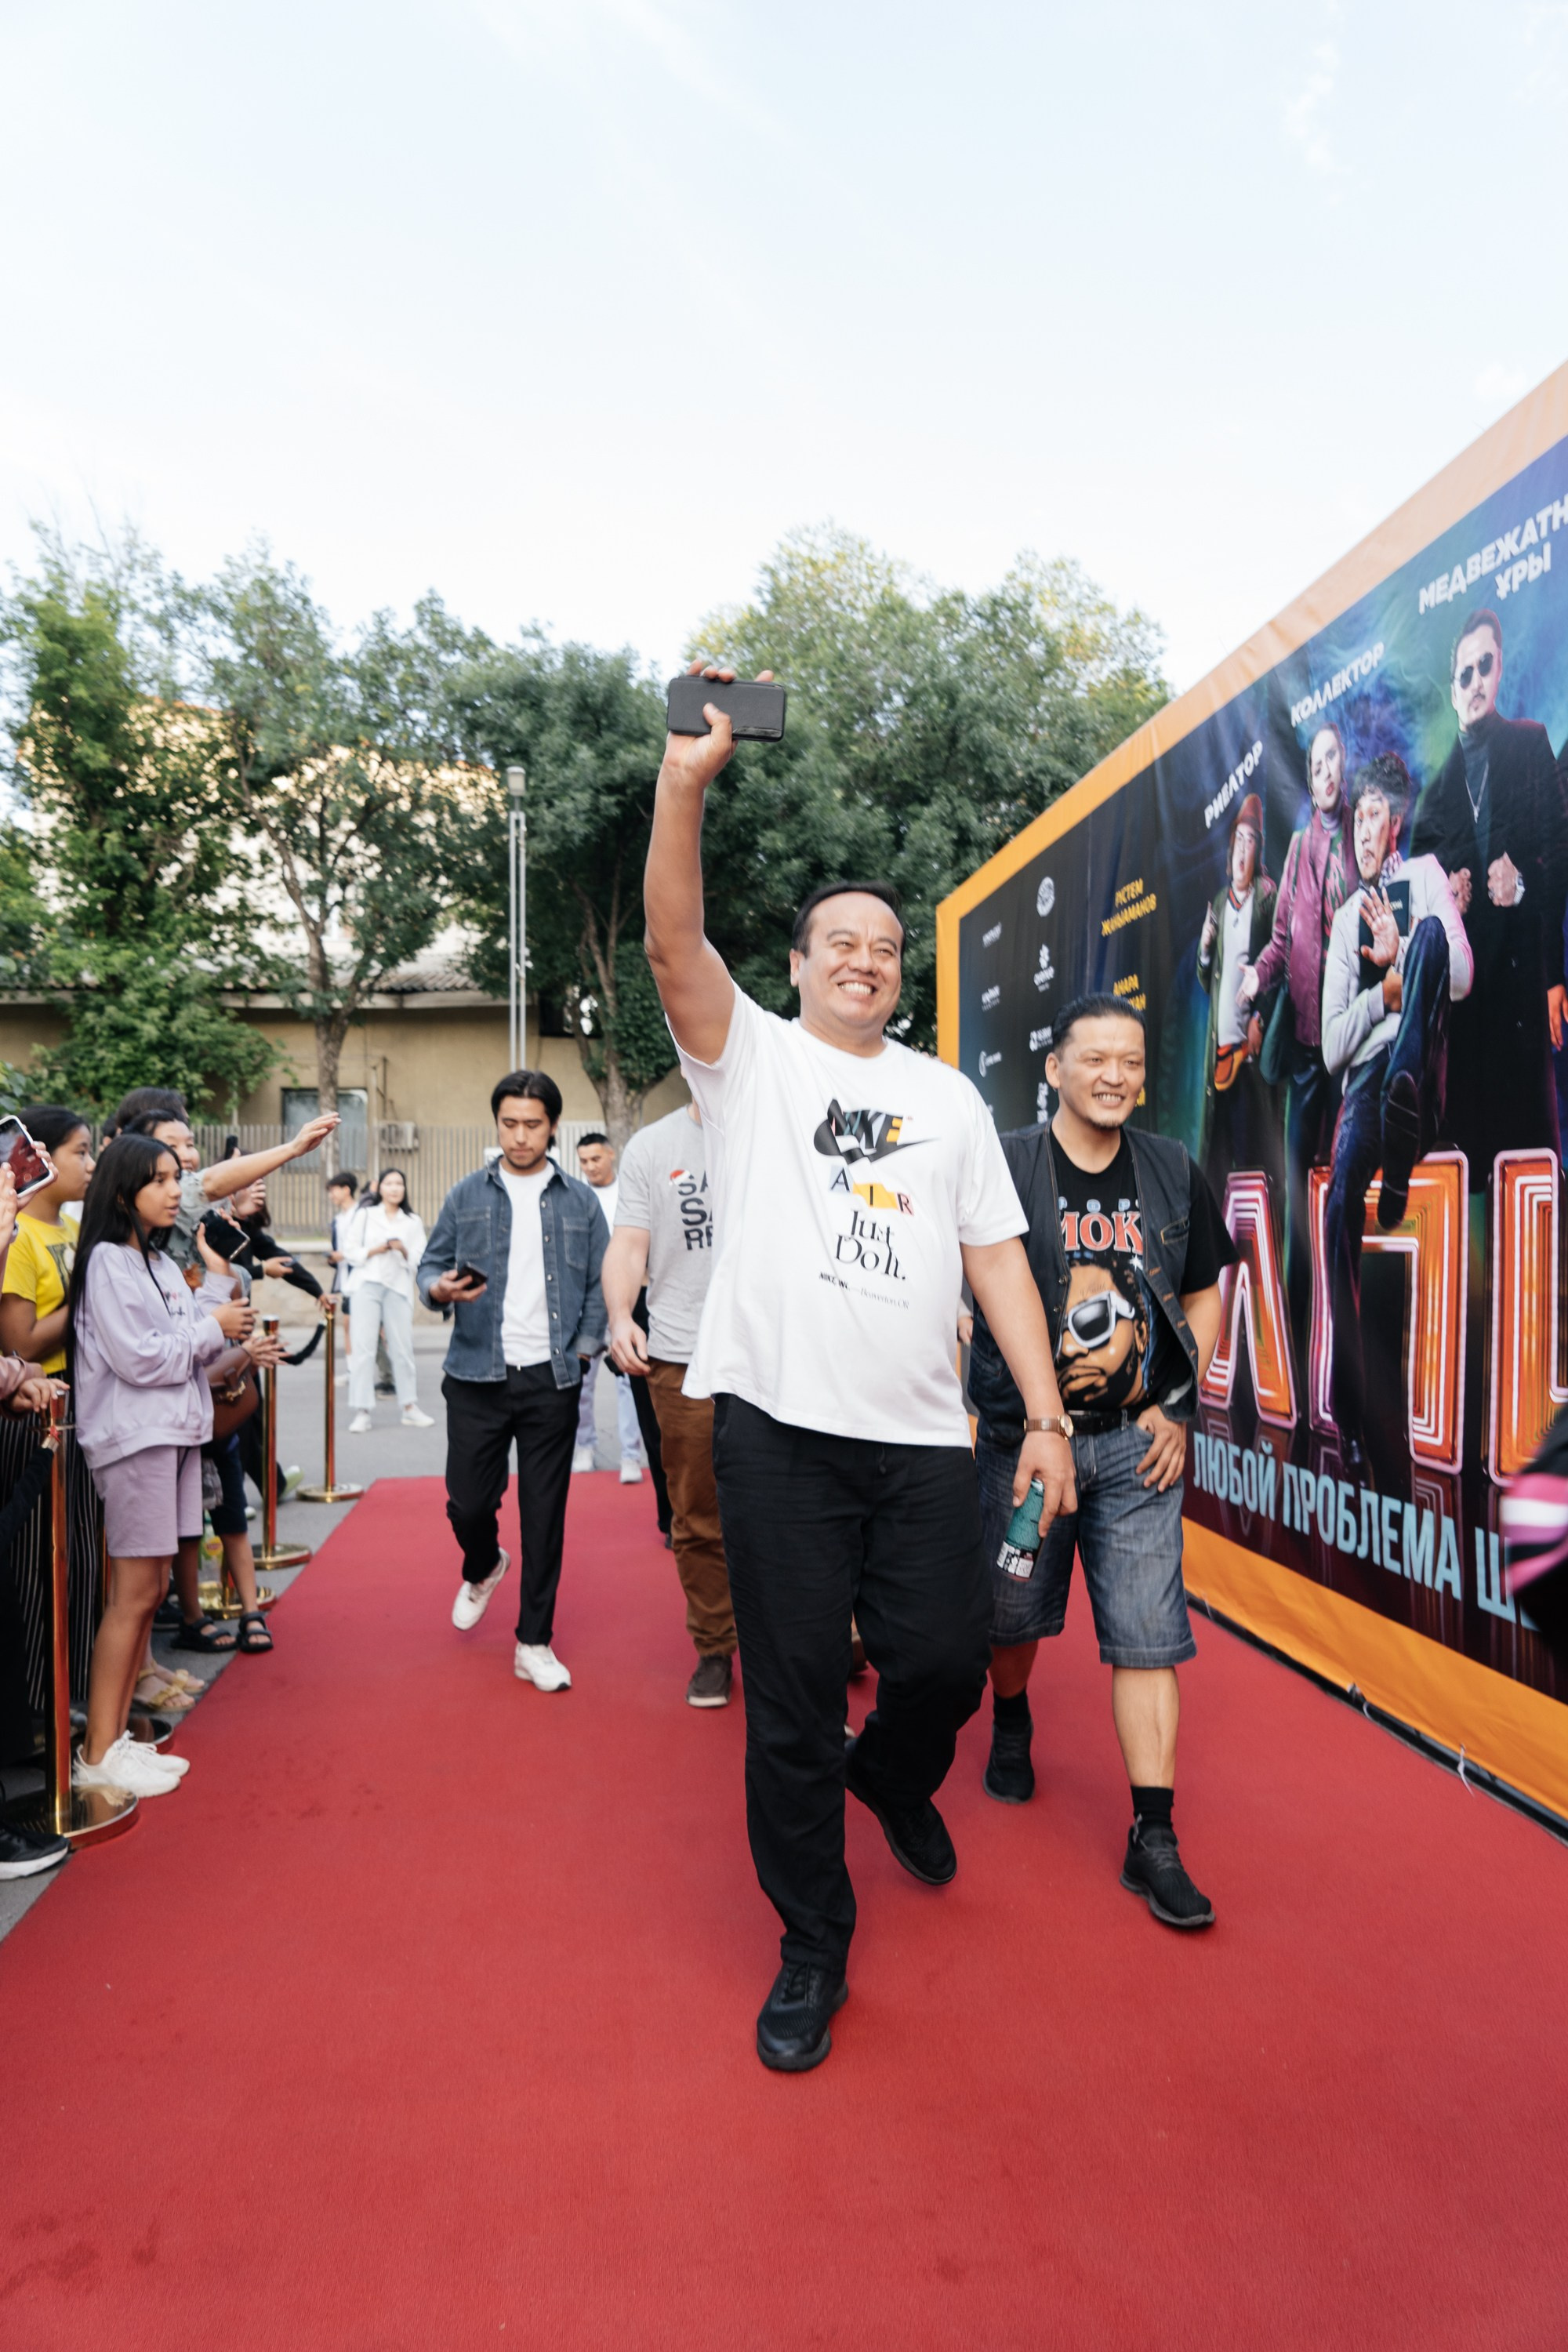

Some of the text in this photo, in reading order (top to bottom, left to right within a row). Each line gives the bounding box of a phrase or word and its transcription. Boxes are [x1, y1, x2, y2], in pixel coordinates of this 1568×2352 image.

[1290, 641, 1385, 728] КОЛЛЕКТОР
[1204, 740, 1263, 829] РИЕЛТОР
[681, 1197, 713, 1226] S
[831, 1167, 913, 1215] AIR
[836, 1233, 880, 1271] Do
[1193, 1432, 1276, 1522] ЛЮБОЙ
[1282, 1461, 1462, 1602] ПРОБЛЕМА
